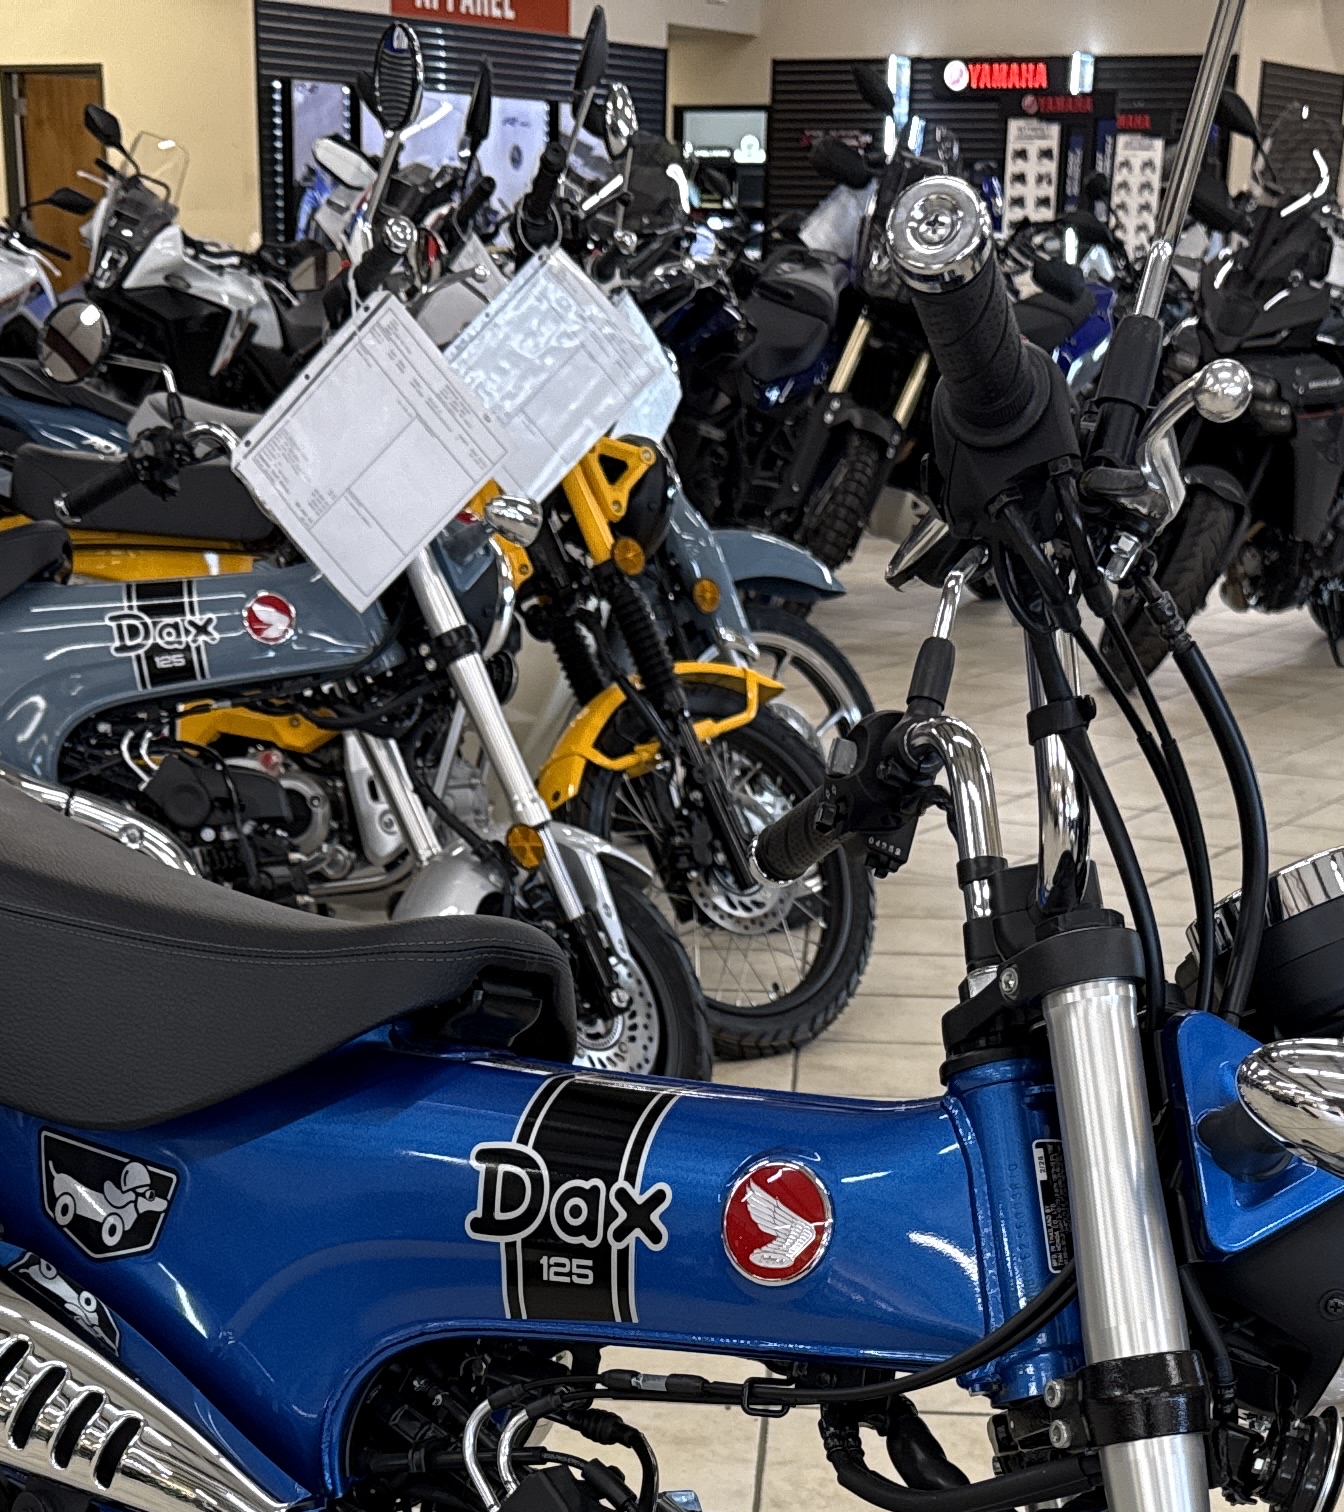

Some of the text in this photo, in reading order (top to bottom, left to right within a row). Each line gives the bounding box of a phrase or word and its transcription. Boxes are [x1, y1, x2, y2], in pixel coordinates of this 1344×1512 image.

[968, 63, 1048, 89] YAMAHA
[104, 608, 220, 657] Dax
[154, 654, 187, 669] 125
[464, 1141, 673, 1251] Dax
[540, 1256, 594, 1285] 125
